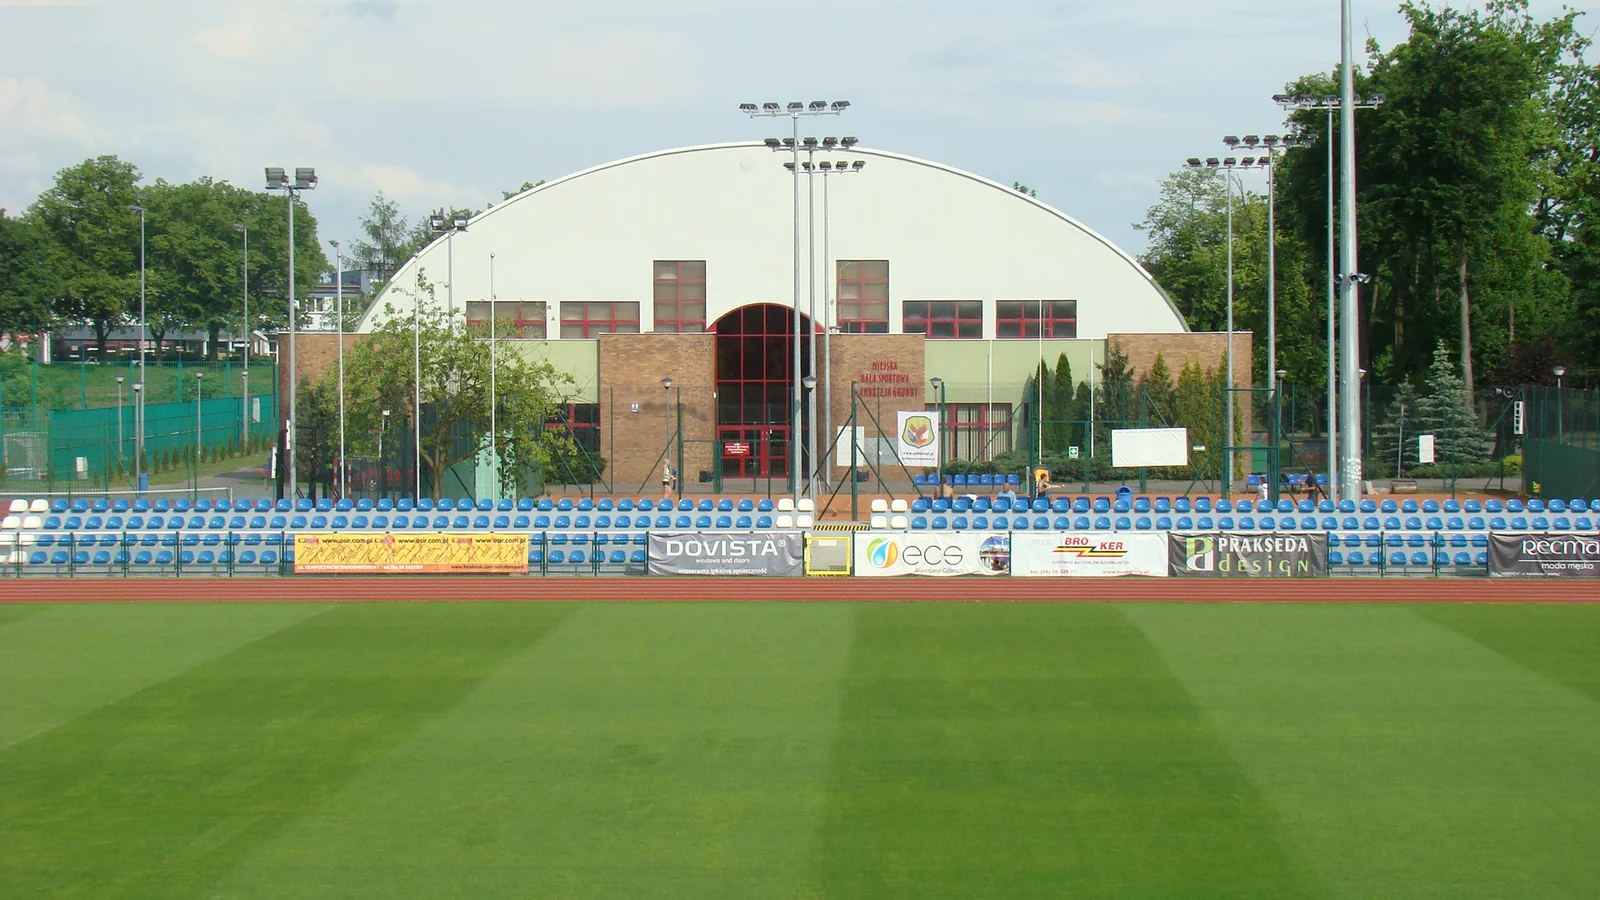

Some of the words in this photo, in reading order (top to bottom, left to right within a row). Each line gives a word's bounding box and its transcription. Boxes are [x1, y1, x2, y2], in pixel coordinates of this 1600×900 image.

[872, 361, 898, 371] MIEJSKA
[860, 374, 877, 383] HALA
[879, 374, 909, 383] SPORTOWA
[893, 386, 918, 397] GRUBBY
[321, 536, 373, 545] www.osir.com.pl
[397, 536, 449, 545] www.osir.com.pl
[475, 536, 526, 545] www.osir.com.pl
[1064, 537, 1089, 546] BRO
[1100, 541, 1123, 550] KER
[1218, 538, 1308, 553] PRAKSEDA
[902, 545, 964, 566] ecs
[1567, 563, 1594, 571] męska
